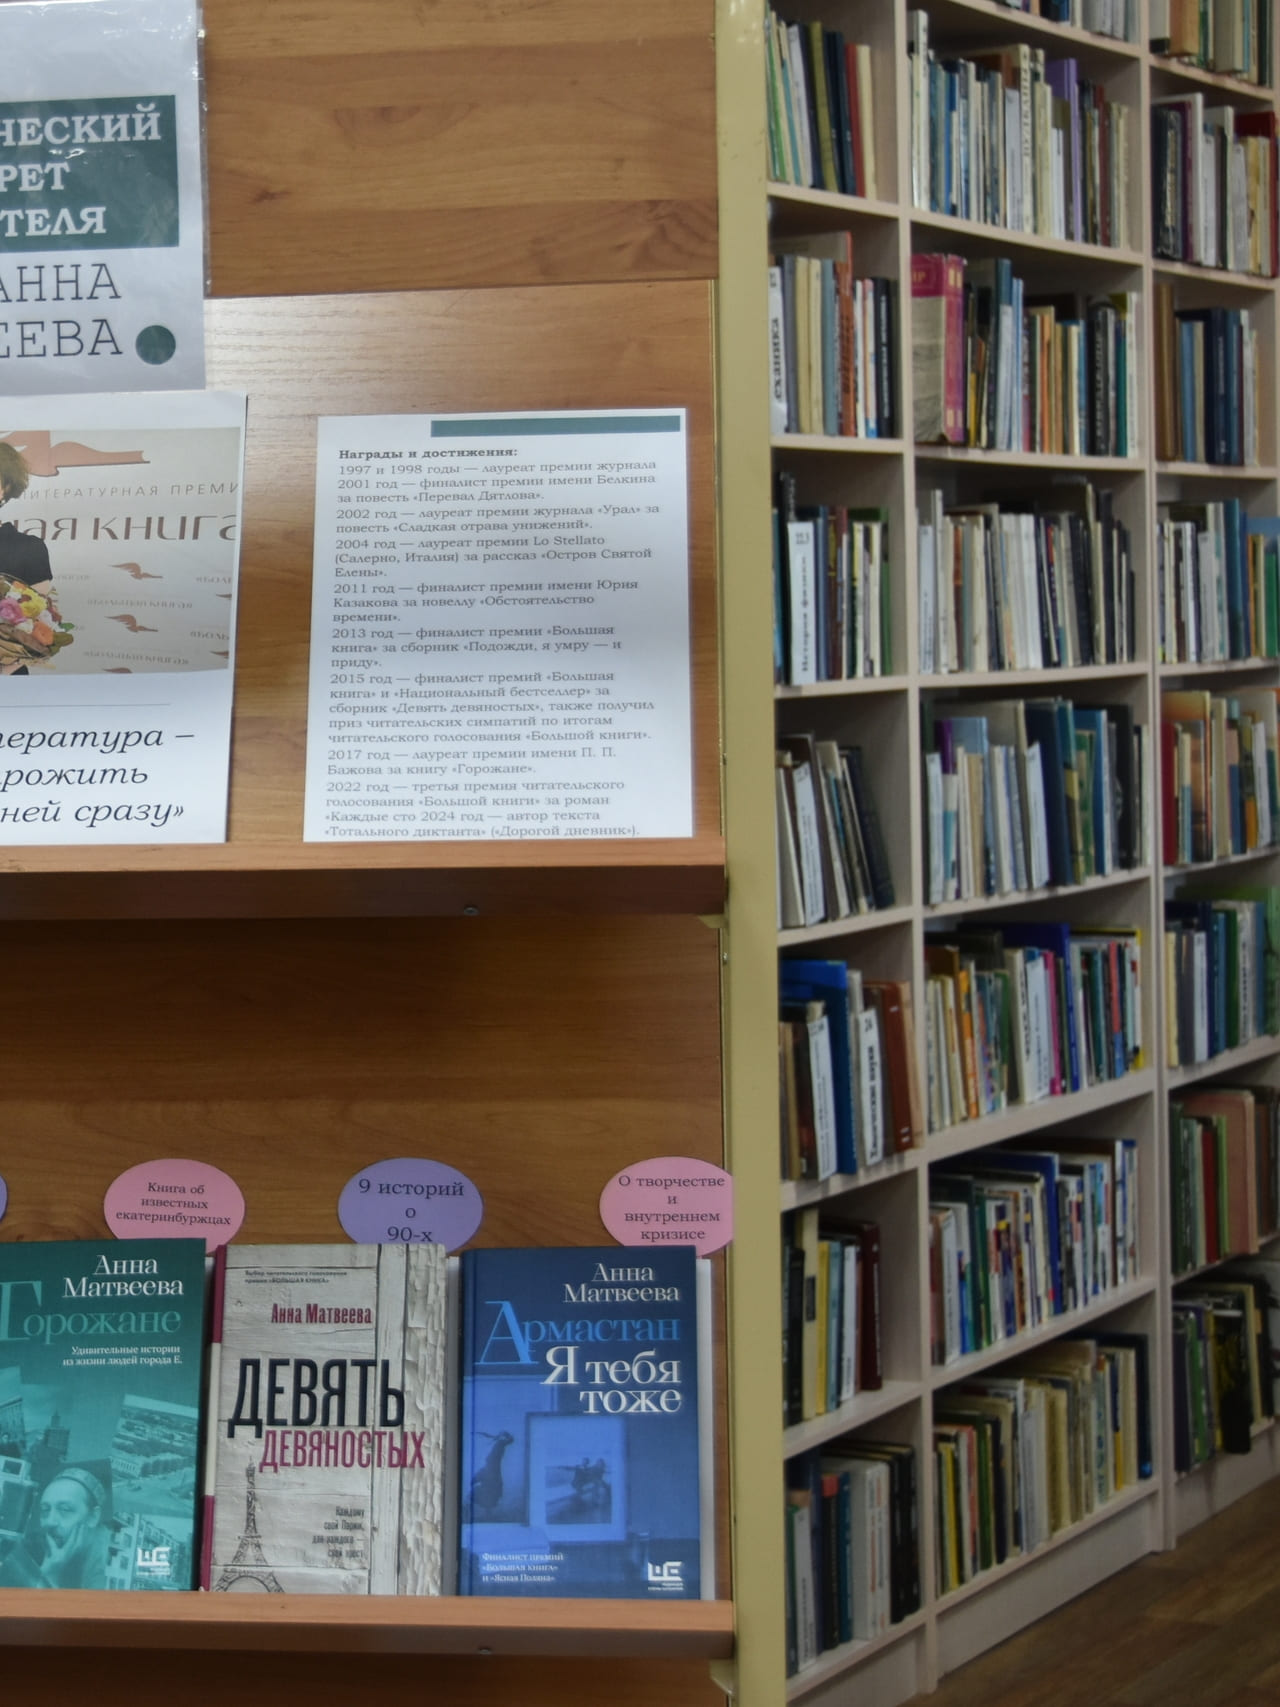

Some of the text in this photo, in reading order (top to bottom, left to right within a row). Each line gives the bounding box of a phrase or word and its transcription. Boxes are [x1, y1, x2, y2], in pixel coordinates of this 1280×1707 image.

[770, 317, 783, 402] еханика
[337, 449, 404, 461] Награды
[420, 448, 518, 459] достижения:
[337, 464, 372, 475] 1997
[390, 463, 423, 474] 1998
[426, 466, 461, 475] годы
[481, 463, 536, 476] лауреат
[538, 463, 593, 475] премии
[595, 460, 657, 473] журнала
[337, 473, 655, 492] 2001 год финалист премии имени Белкина
[22, 486, 158, 499] ИТЕРАТУРНАЯ
[334, 535, 606, 552] 2004 год лауреат премии Lo Stellato
[74, 803, 184, 828] сразу»
[146, 1181, 205, 1195] Книга об
[357, 1178, 464, 1200] 9 историй
[618, 1175, 725, 1190] О творчестве
[139, 1198, 210, 1209] известных
[666, 1195, 679, 1204] и
[113, 1210, 233, 1227] екатеринбуржцах
[403, 1207, 418, 1218] о
[622, 1212, 722, 1224] внутреннем
[386, 1226, 434, 1244] 90-х
[639, 1230, 707, 1243] кризисе
[93, 1255, 159, 1276] Анна
[591, 1263, 655, 1282] Анна
[62, 1277, 184, 1298] Матвеева
[563, 1283, 679, 1303] Матвеева
[271, 1303, 373, 1324] Анна Матвеева
[474, 1301, 681, 1365] Армастан
[71, 1345, 180, 1356] Удивительные истории
[62, 1358, 74, 1366] из
[106, 1355, 138, 1365] людей
[139, 1355, 172, 1366] города
[173, 1354, 183, 1364] Е.
[539, 1345, 682, 1385] Я тебя
[228, 1358, 406, 1438] ДЕВЯТЬ
[579, 1388, 682, 1414] тоже
[259, 1430, 426, 1473] ДЕВЯНОСТЫХ
